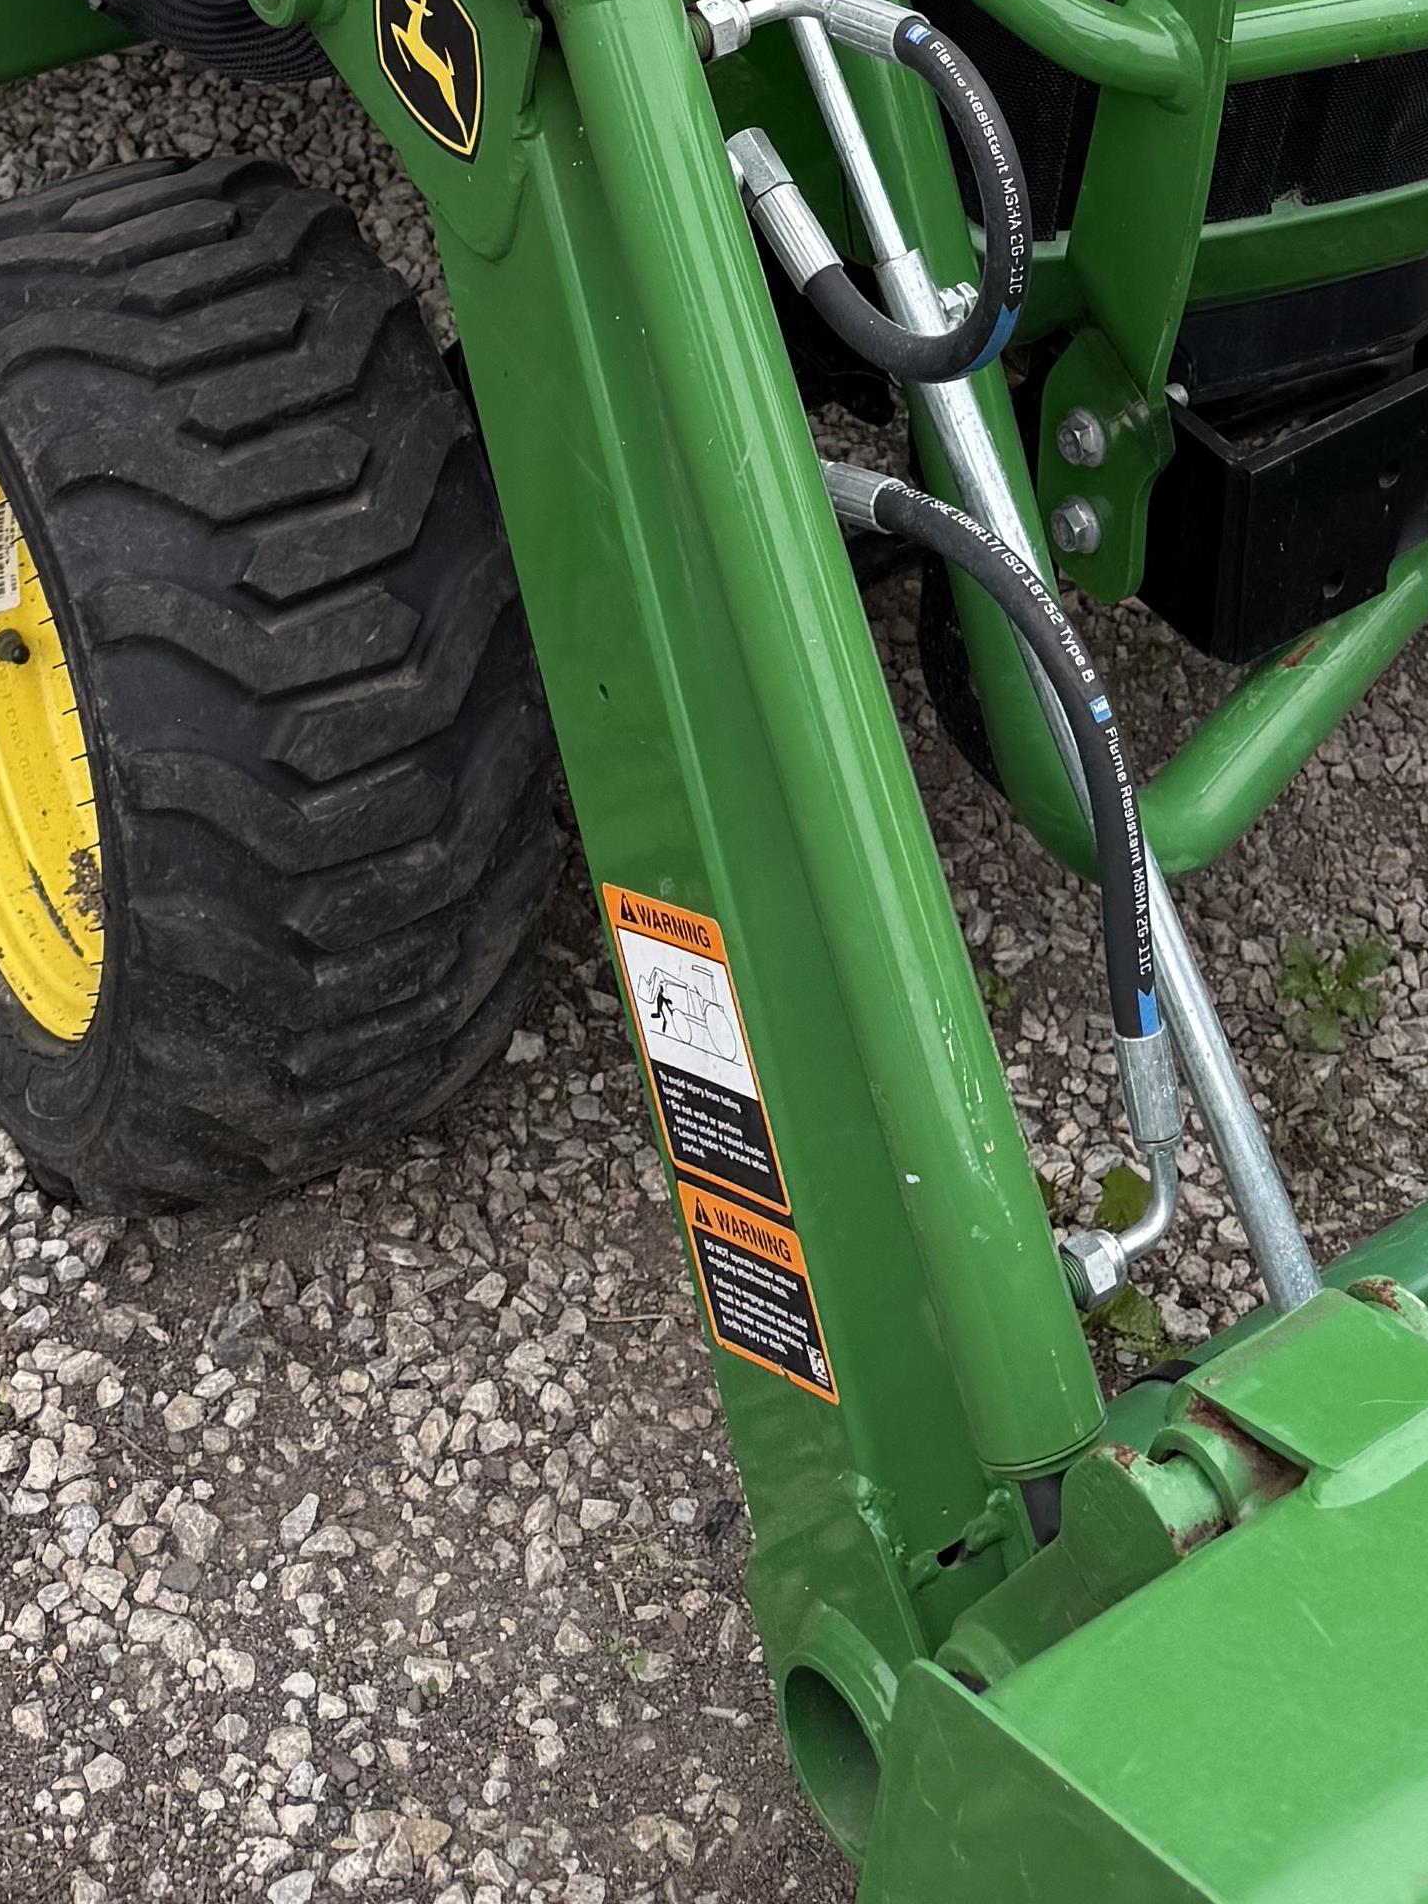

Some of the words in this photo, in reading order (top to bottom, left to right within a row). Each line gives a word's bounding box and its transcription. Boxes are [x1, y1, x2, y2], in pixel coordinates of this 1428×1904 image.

[1001, 549, 1027, 575] ISO
[1022, 576, 1065, 625] 18752
[1059, 625, 1086, 667] Type
[1082, 668, 1096, 683] B
[1105, 726, 1127, 783] Flame
[1120, 785, 1143, 864] Resistant
[1132, 866, 1147, 916] MSHA
[636, 903, 712, 950] WARNING
[713, 1207, 792, 1263] WARNING
